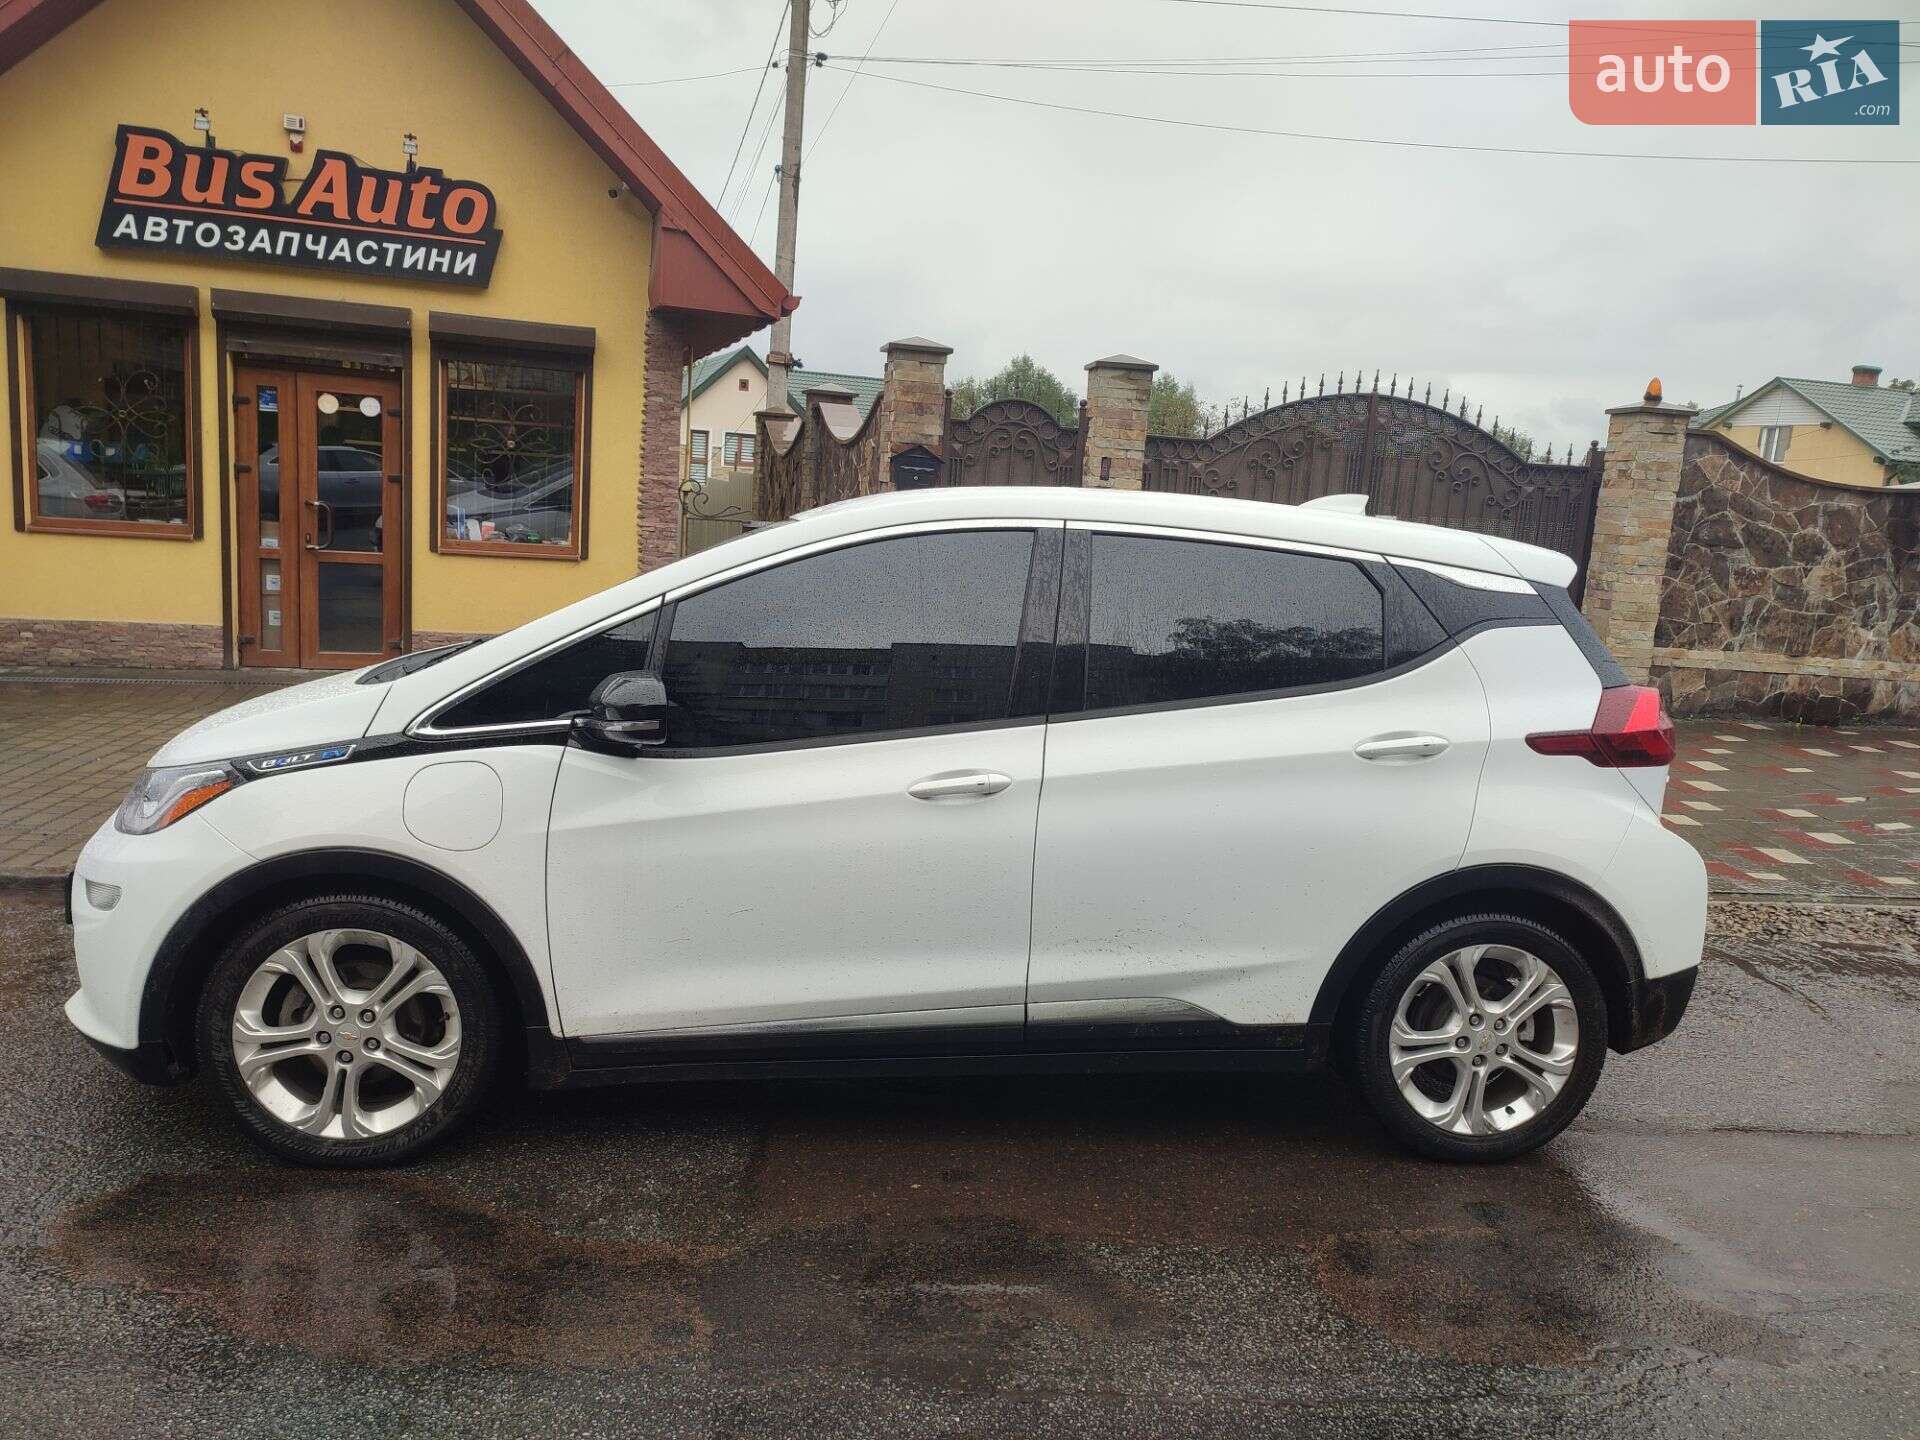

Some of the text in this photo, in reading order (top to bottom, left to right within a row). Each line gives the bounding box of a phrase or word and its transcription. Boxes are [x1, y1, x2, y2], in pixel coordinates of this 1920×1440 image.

[117, 133, 490, 234] Bus Auto
[113, 213, 477, 276] АВТОЗАПЧАСТИНИ
